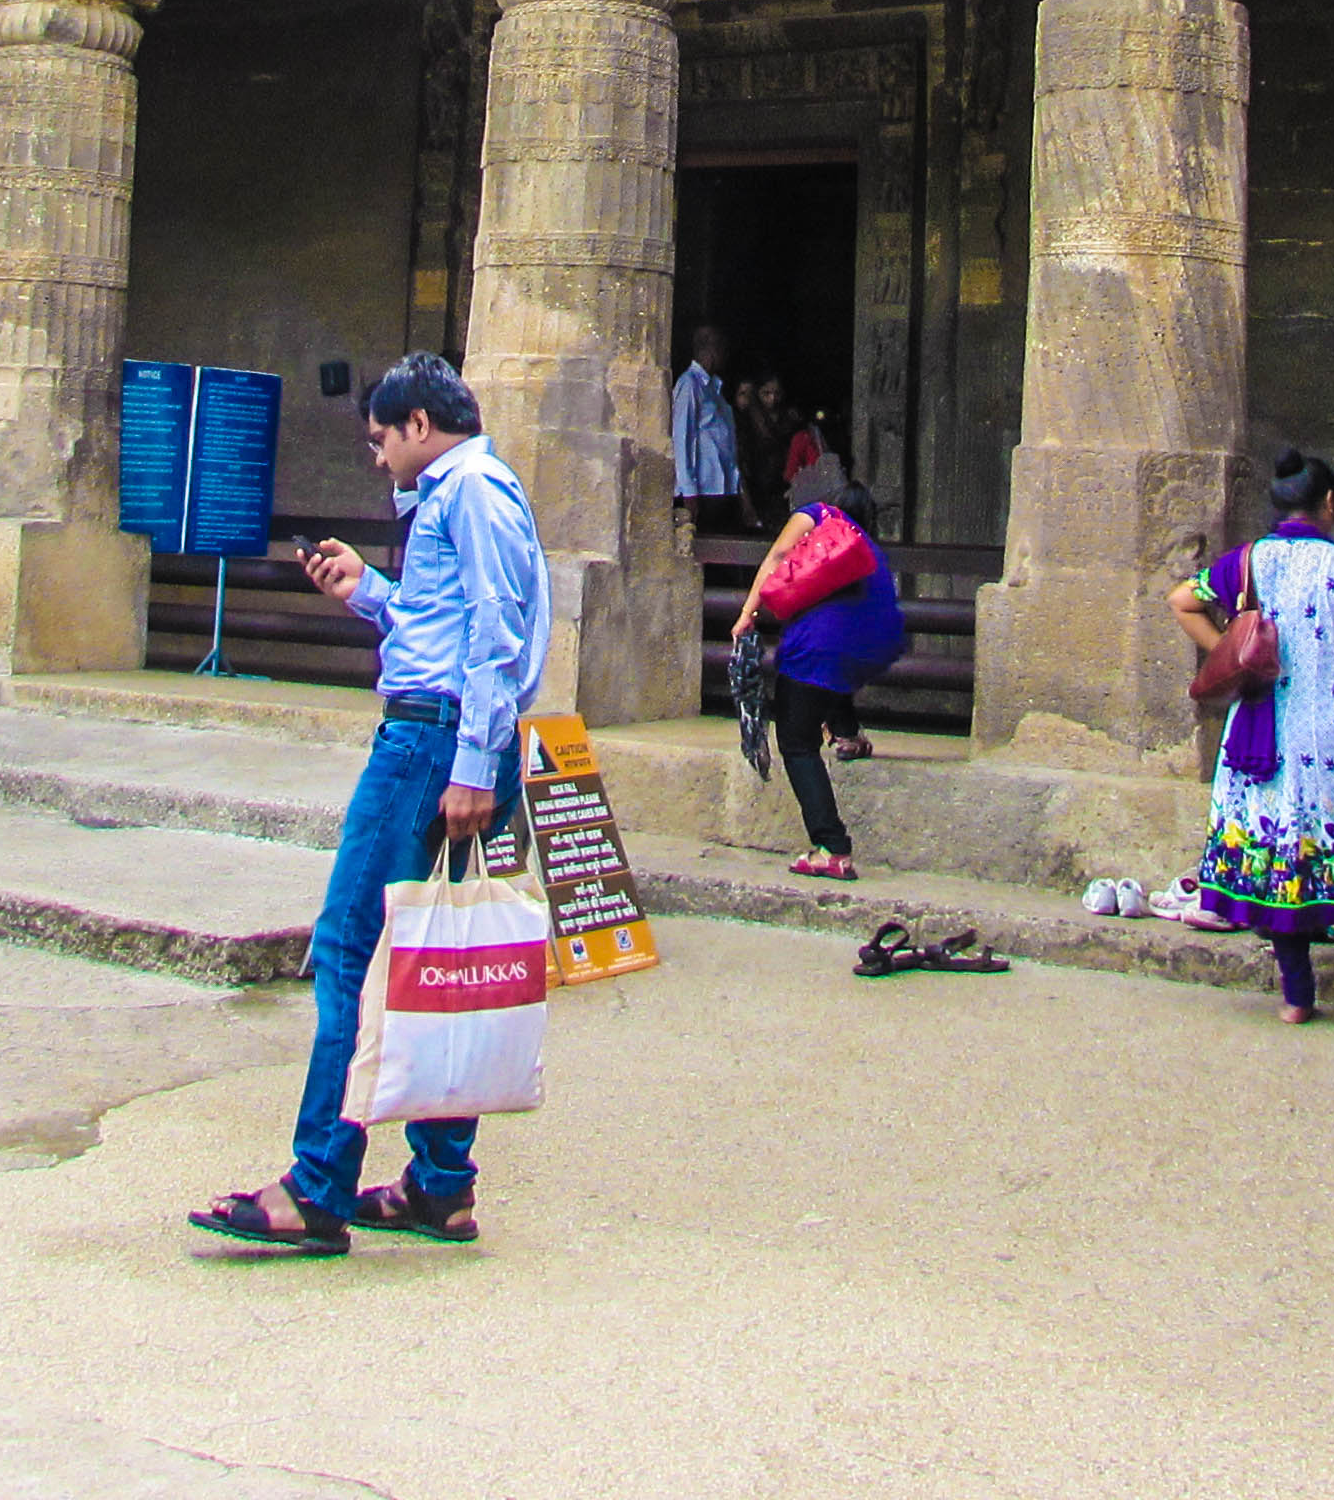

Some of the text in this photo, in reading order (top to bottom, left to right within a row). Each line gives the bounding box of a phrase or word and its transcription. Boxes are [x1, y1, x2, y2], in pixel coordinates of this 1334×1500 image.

[138, 370, 162, 380] NOTICE
[554, 742, 589, 756] CAUTION
[581, 792, 601, 805] PLEASE
[567, 810, 577, 821] THE
[595, 805, 608, 817] SIDE
[417, 966, 446, 987] JOS
